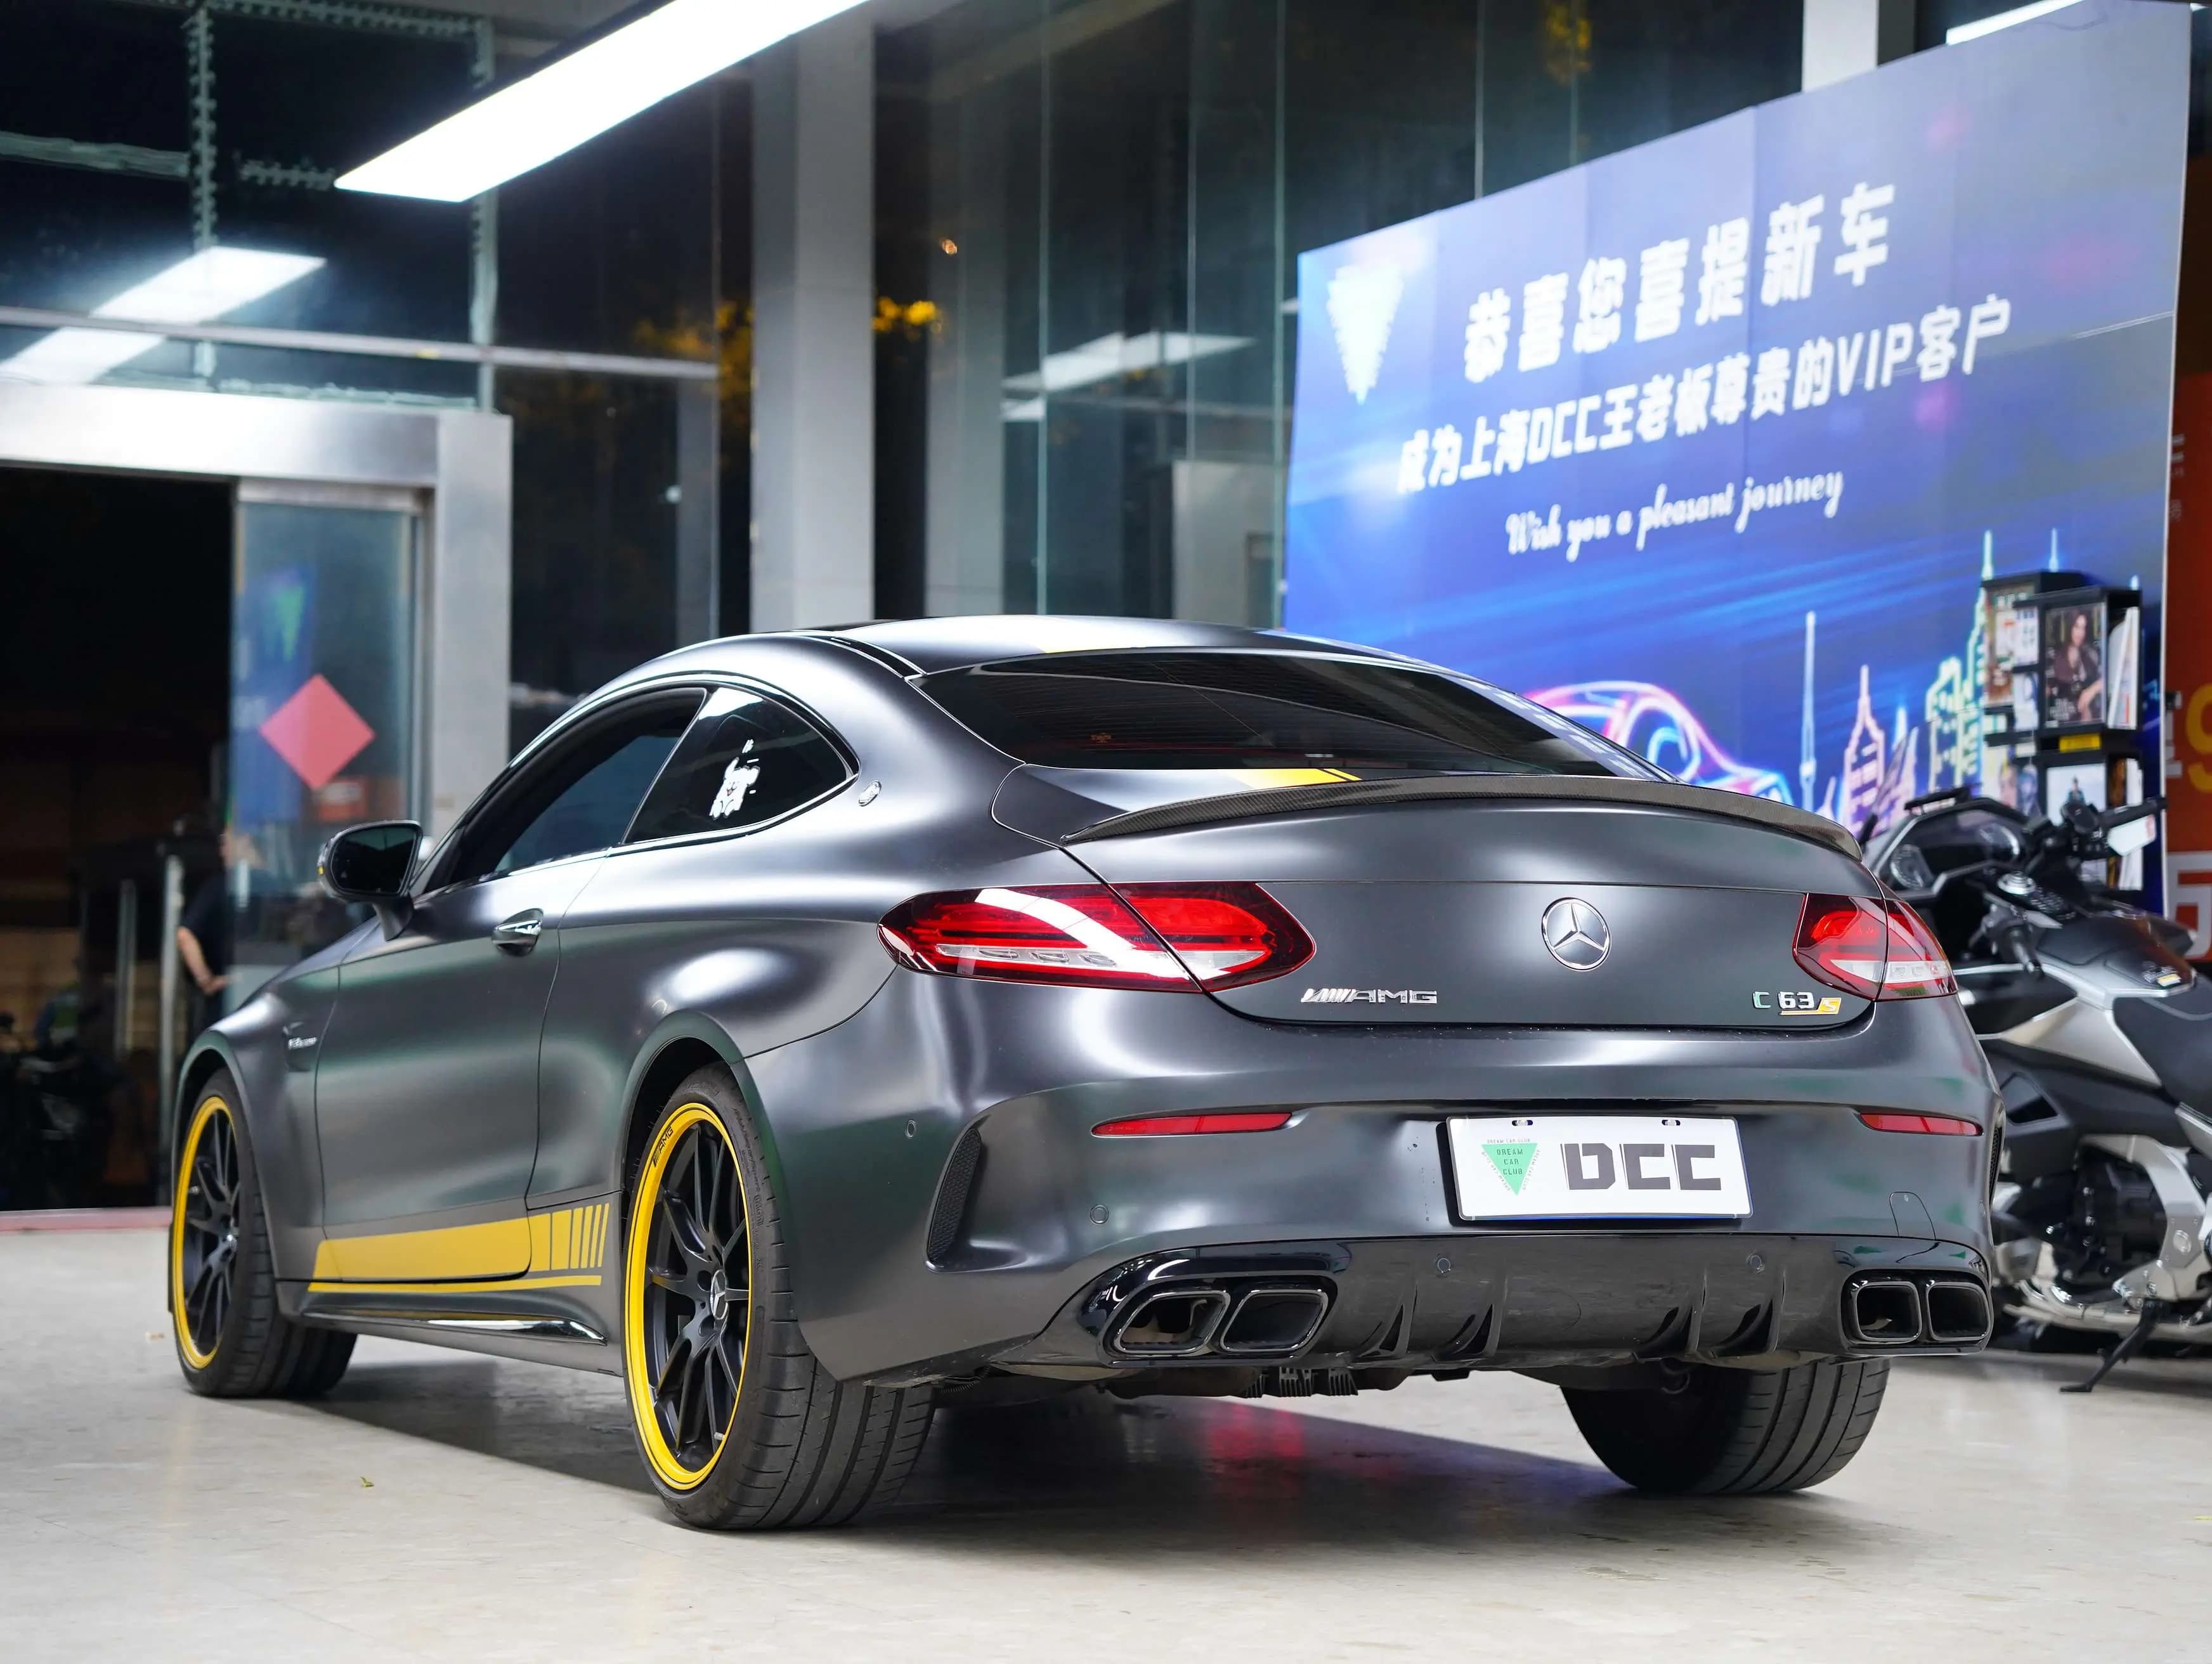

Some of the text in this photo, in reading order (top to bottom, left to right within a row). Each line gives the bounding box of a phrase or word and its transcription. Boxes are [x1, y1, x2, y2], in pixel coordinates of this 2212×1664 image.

[1464, 181, 1896, 384] 恭喜您喜提新车
[1396, 294, 2011, 494] 成为上海DCC王老板尊贵的VIP客户
[1506, 471, 1844, 562] Wish you a pleasant journey
[1339, 988, 1438, 1004] AMG
[1752, 991, 1771, 1009] C
[1560, 1143, 1721, 1191] DCC
